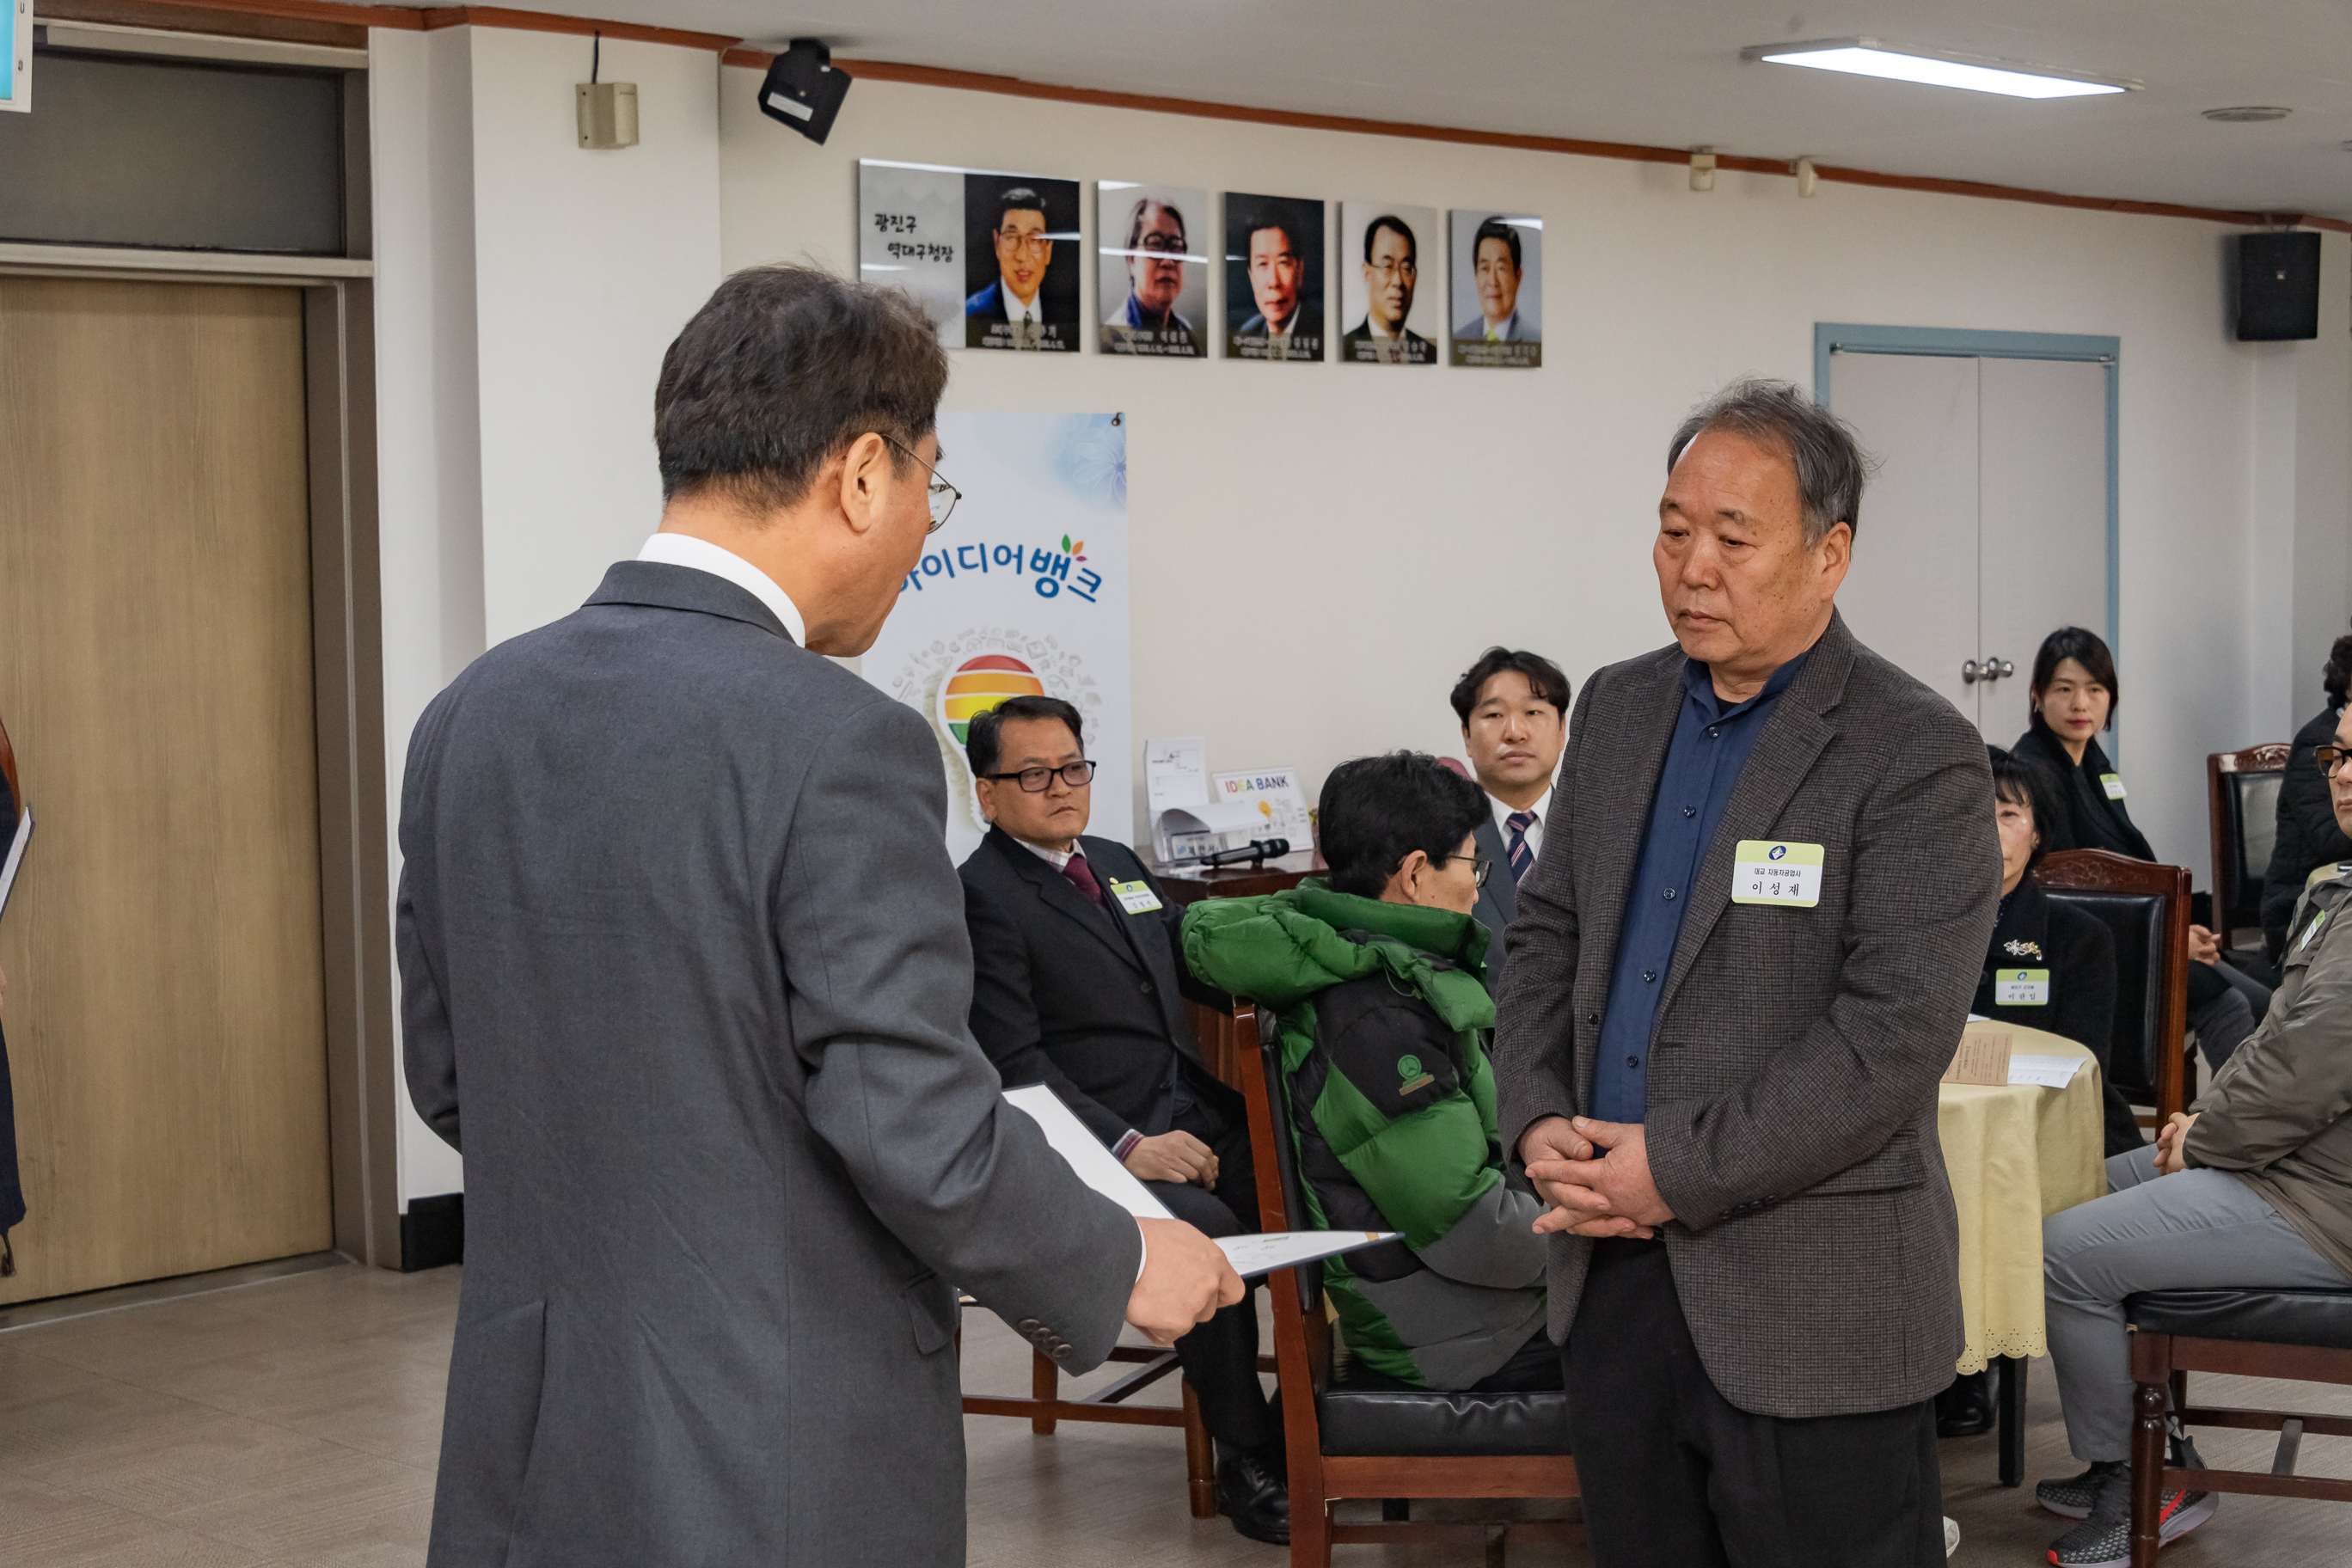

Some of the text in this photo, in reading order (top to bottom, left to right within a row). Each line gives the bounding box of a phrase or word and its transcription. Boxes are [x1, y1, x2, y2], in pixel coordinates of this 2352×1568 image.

[874, 213, 916, 234] 광진구
[887, 242, 955, 263] 역대구청장
[1225, 775, 1289, 793] IDEA BANK
